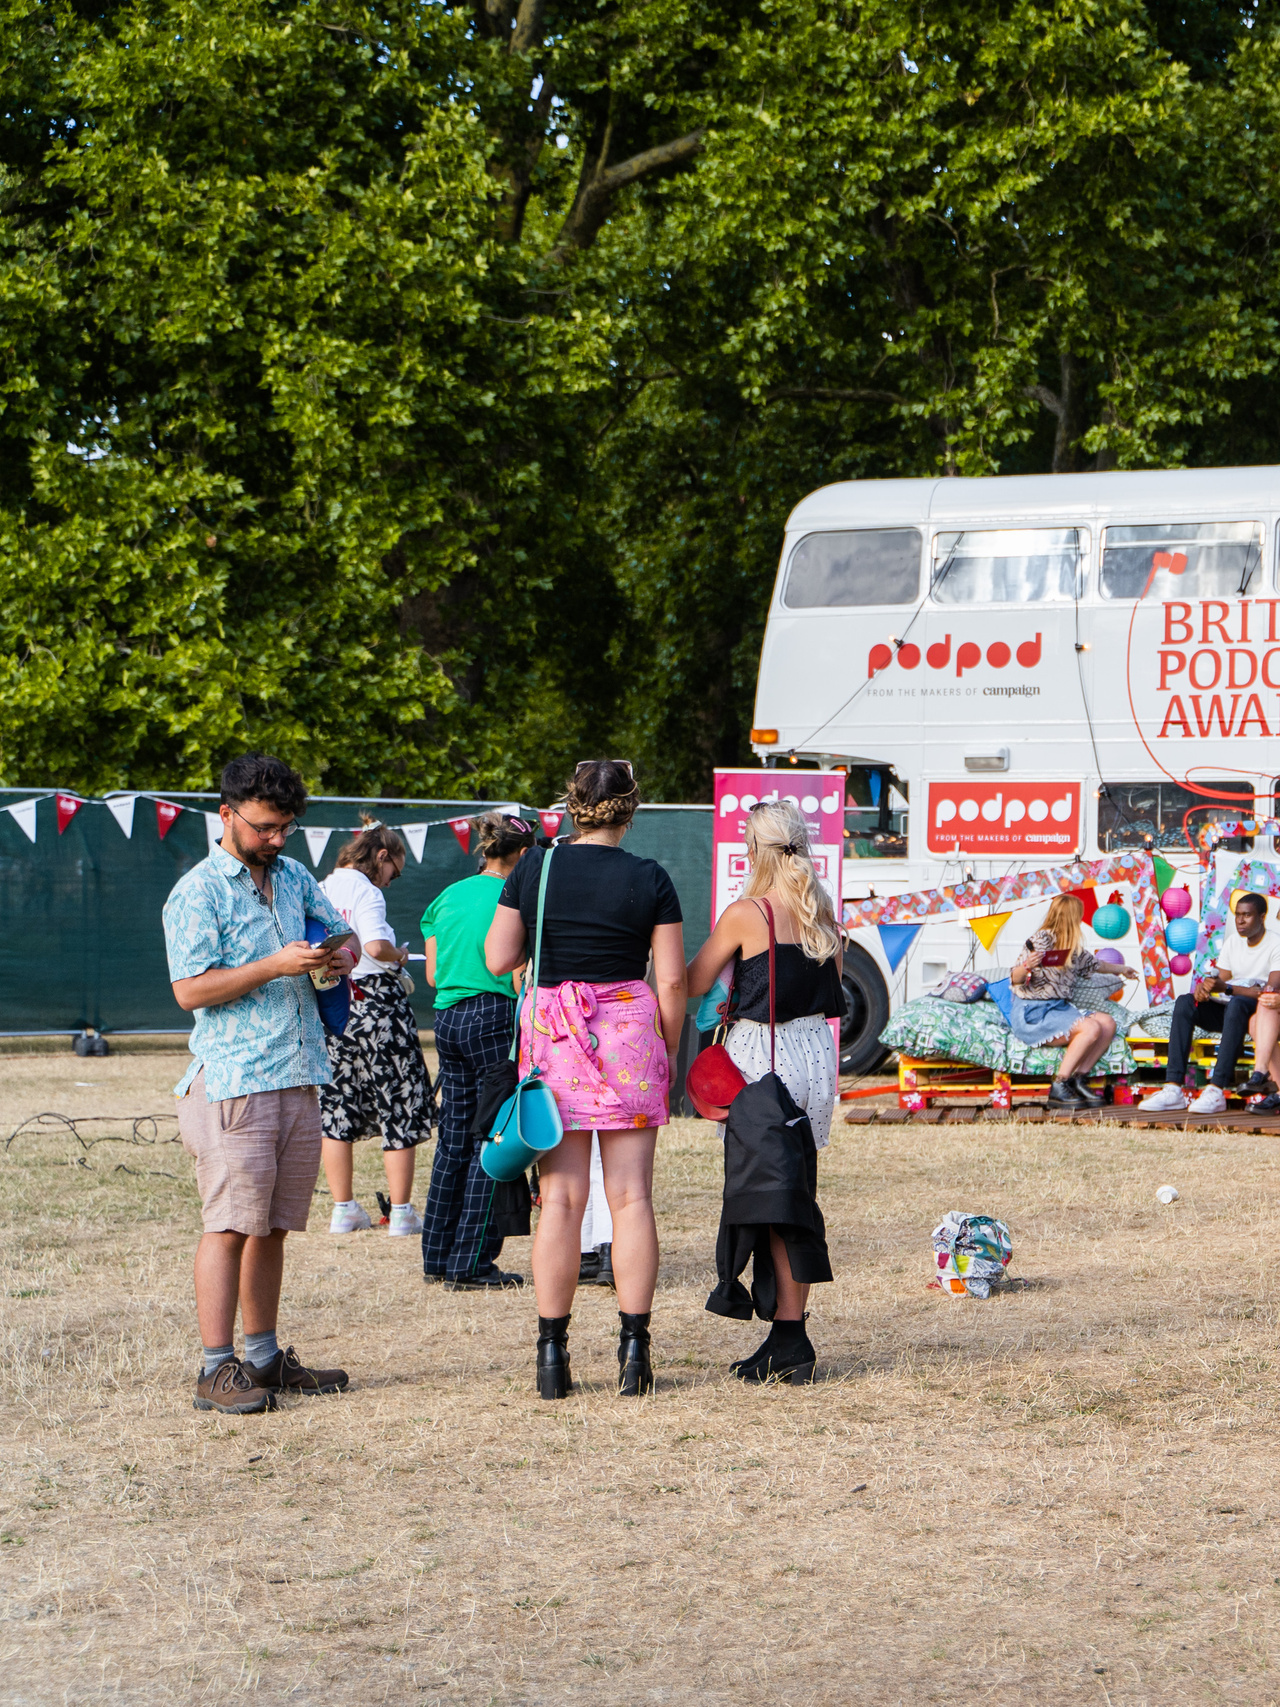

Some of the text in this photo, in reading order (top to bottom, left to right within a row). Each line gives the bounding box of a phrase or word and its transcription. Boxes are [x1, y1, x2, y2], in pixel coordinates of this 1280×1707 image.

[868, 632, 1042, 679] podpod
[867, 684, 1041, 698] FROM THE MAKERS OF campaign
[935, 792, 1073, 828] podpod
[935, 832, 1071, 844] FROM THE MAKERS OF campaign
